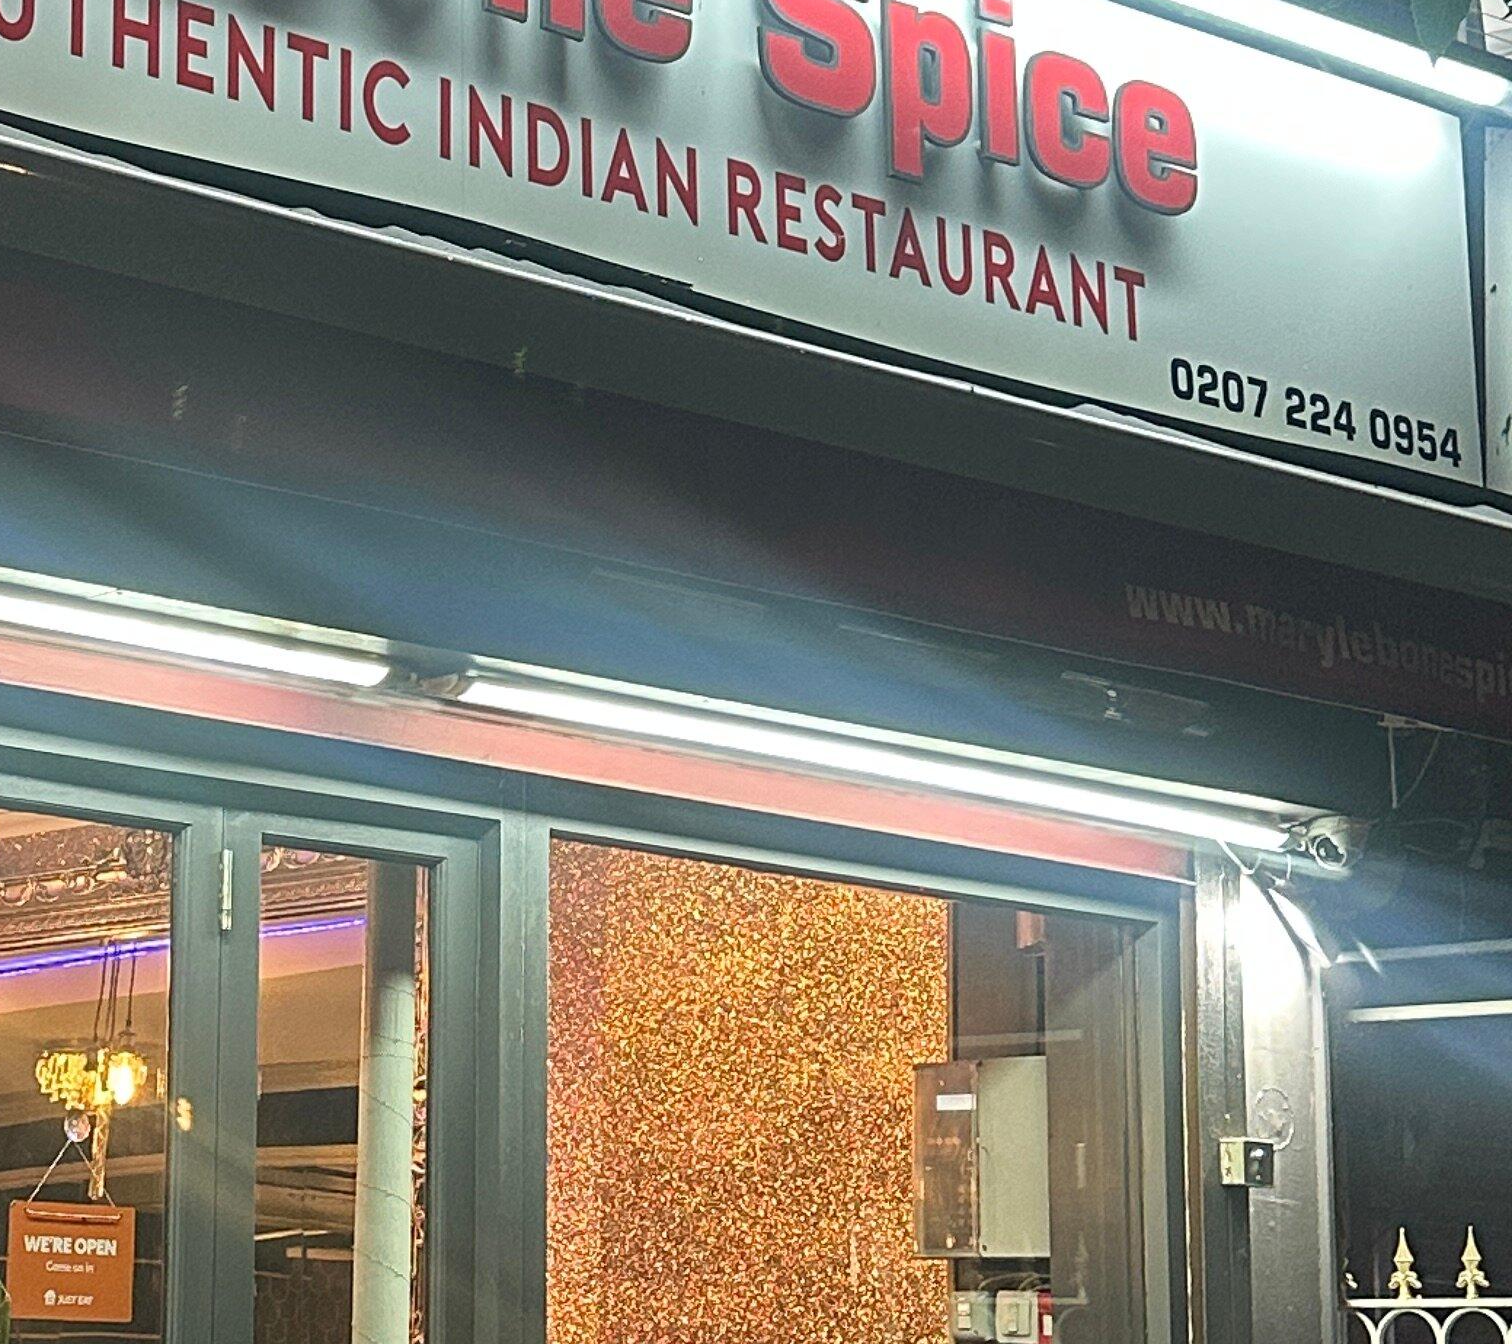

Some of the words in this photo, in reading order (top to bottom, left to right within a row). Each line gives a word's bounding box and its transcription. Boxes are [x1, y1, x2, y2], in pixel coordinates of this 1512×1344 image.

[439, 77, 700, 227] INDIAN
[727, 158, 1147, 342] RESTAURANT
[1170, 357, 1269, 418] 0207
[1284, 388, 1357, 443] 224
[1369, 410, 1462, 469] 0954
[24, 1234, 73, 1255] WE'RE
[74, 1237, 118, 1256] OPEN
